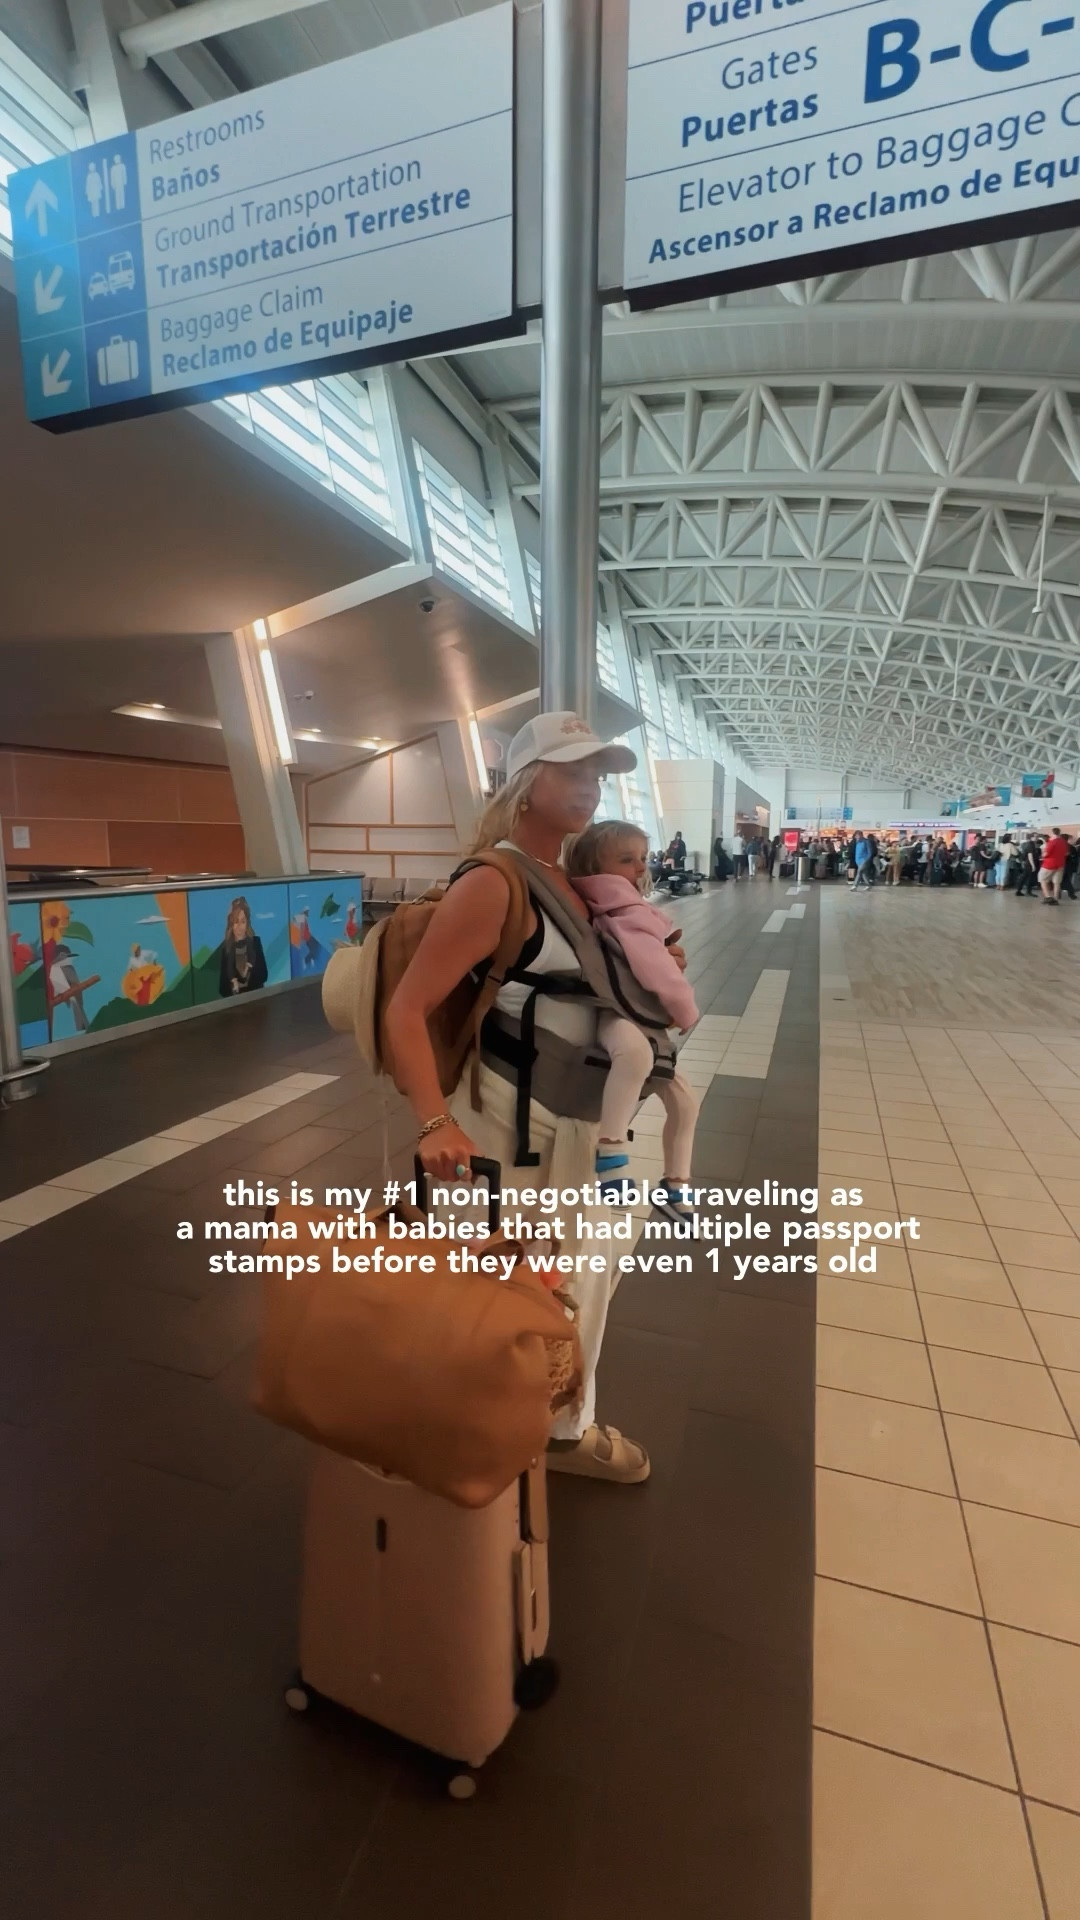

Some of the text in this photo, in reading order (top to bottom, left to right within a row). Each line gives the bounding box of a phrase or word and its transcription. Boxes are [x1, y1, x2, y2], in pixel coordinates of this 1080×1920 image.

[686, 0, 806, 34] Puer
[722, 46, 819, 90] Gates
[149, 109, 266, 163] Restrooms
[682, 93, 819, 148] Puertas
[151, 163, 221, 201] Baños
[679, 161, 816, 213] Elevator
[826, 152, 863, 180] to
[877, 110, 1046, 169] Baggage
[156, 158, 422, 252] Ground Transportation
[648, 219, 779, 264] Ascensor
[787, 215, 803, 235] a
[813, 184, 950, 230] Reclamo
[960, 169, 1002, 199] de
[157, 188, 471, 289] Transportación Terrestre
[161, 285, 323, 342] Baggage Claim
[163, 300, 413, 376] Reclamo de Equipaje
